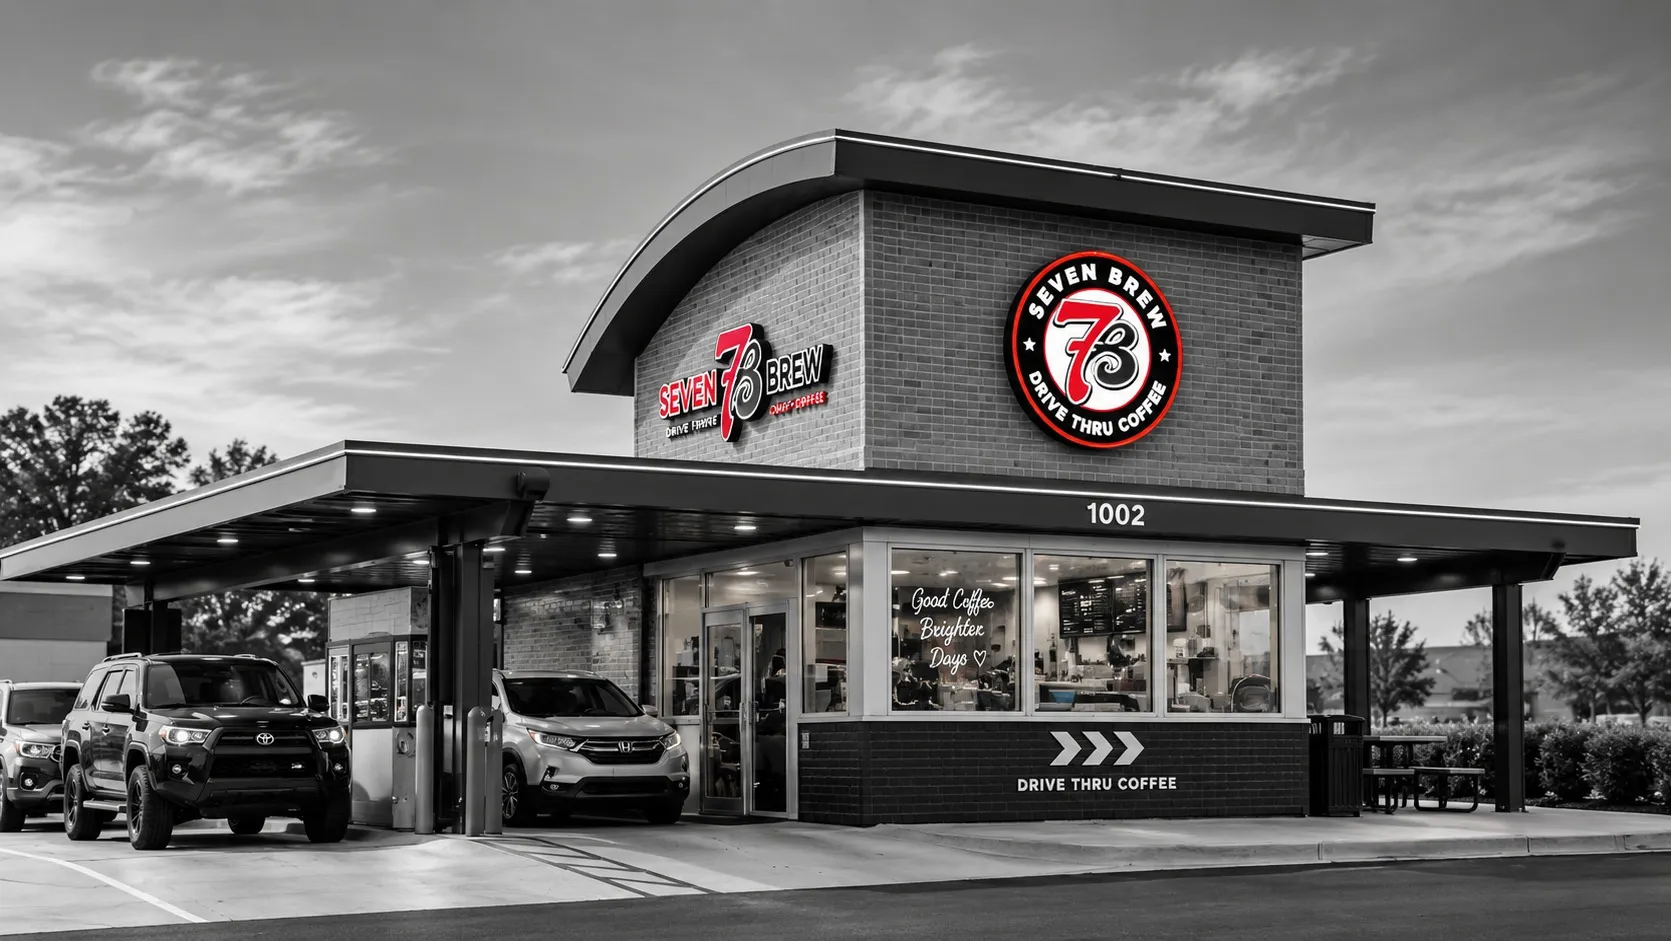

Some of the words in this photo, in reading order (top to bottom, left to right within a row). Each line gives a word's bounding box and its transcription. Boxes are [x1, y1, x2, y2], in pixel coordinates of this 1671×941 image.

[1028, 263, 1097, 320] SEVEN
[1108, 266, 1167, 330] BREW
[659, 368, 718, 420] SEVEN
[766, 344, 824, 396] BREW
[1029, 370, 1069, 422] DRIVE
[1071, 414, 1114, 436] THRU
[1118, 380, 1167, 432] COFFEE
[1086, 502, 1145, 527] 1002
[911, 587, 950, 616] Good
[919, 615, 985, 646] Brighter
[929, 646, 968, 676] Days
[1017, 778, 1066, 792] DRIVE
[1071, 777, 1112, 791] THRU
[1117, 776, 1177, 791] COFFEE
